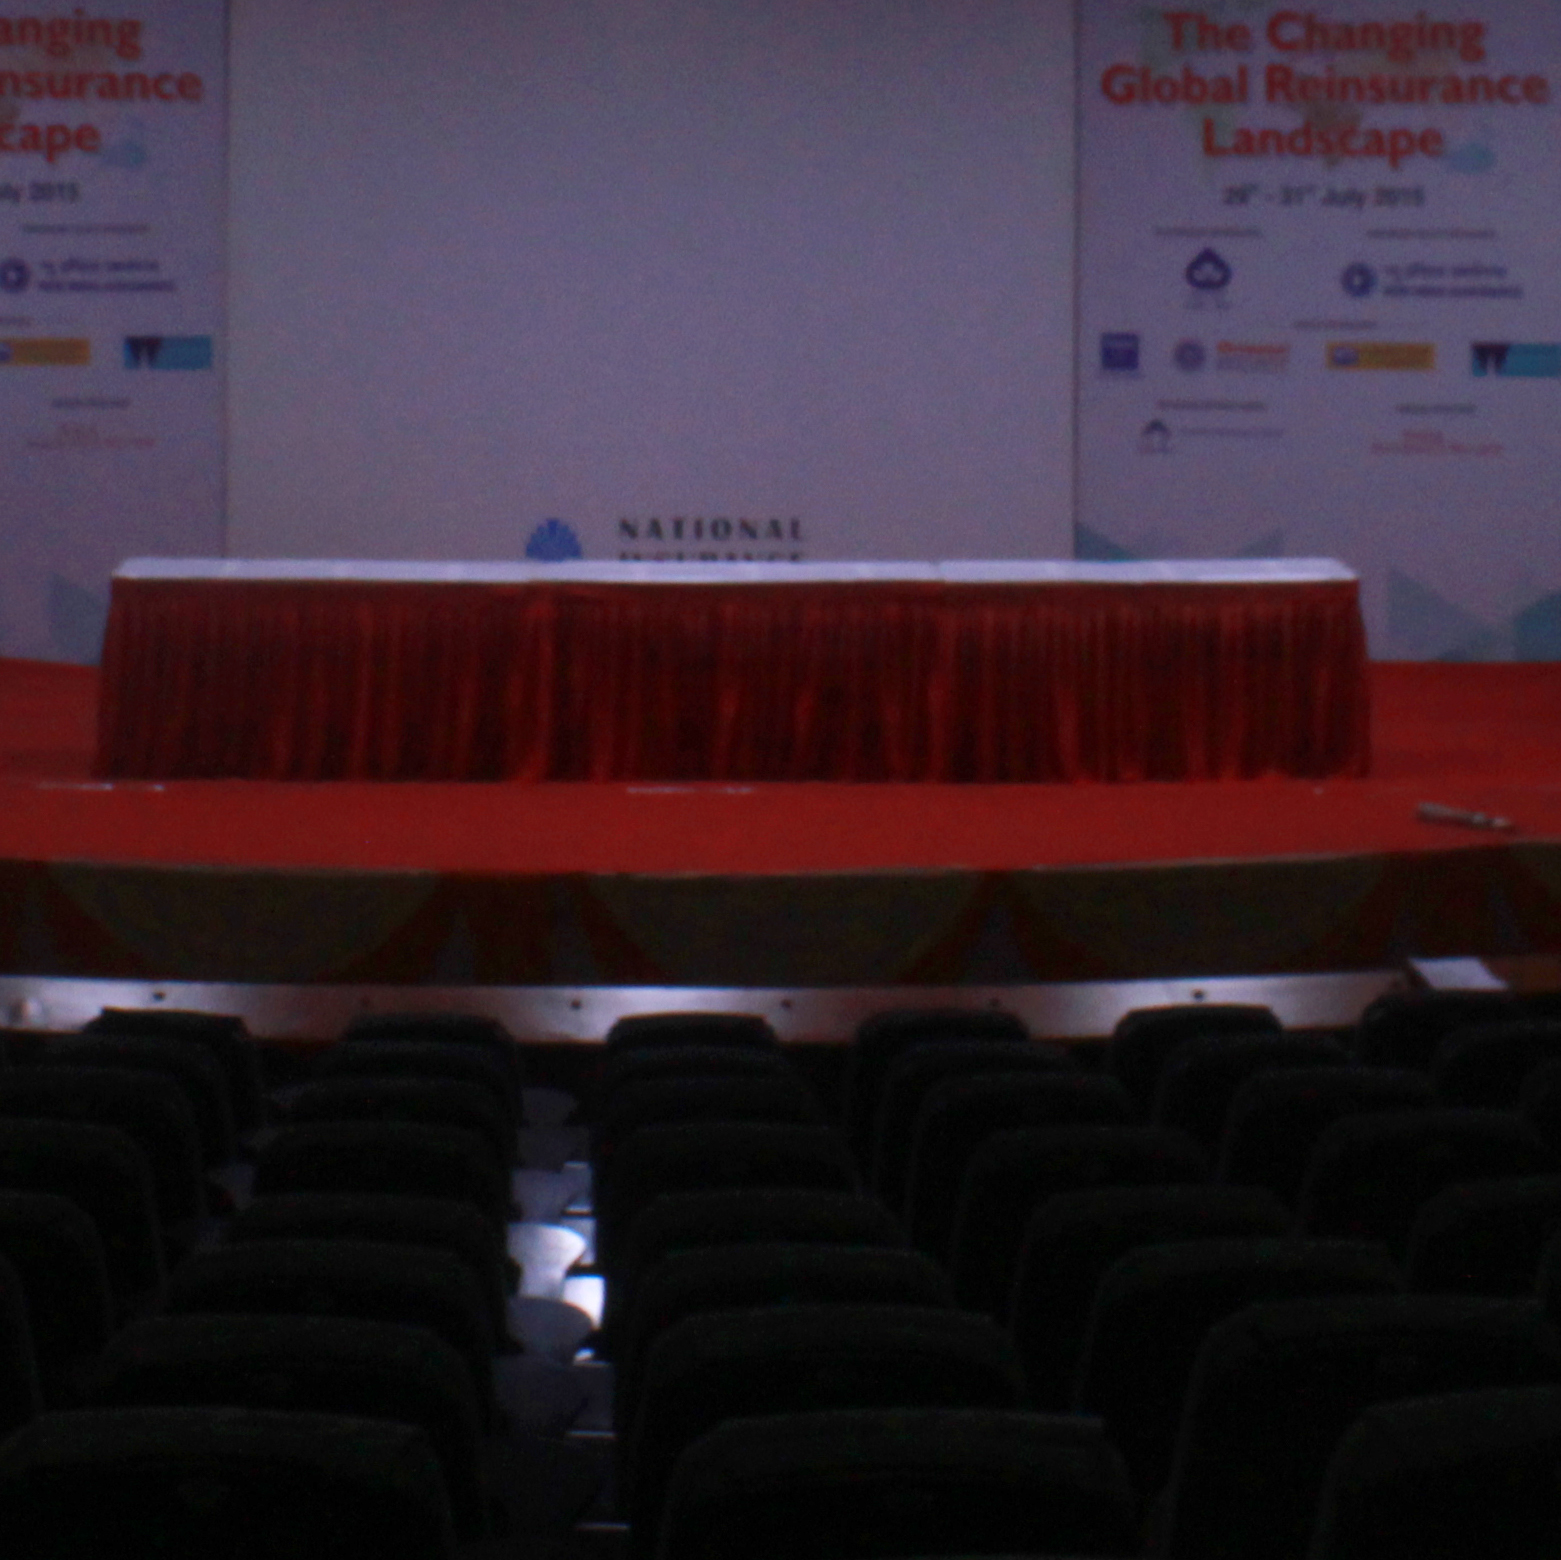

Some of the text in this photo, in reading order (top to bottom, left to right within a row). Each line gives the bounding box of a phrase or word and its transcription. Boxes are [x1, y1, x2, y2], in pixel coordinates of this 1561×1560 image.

[1162, 11, 1487, 62] The Changing
[1100, 63, 1550, 105] Global Reinsurance
[1202, 117, 1445, 170] Landscape
[618, 518, 800, 540] NATIONAL
